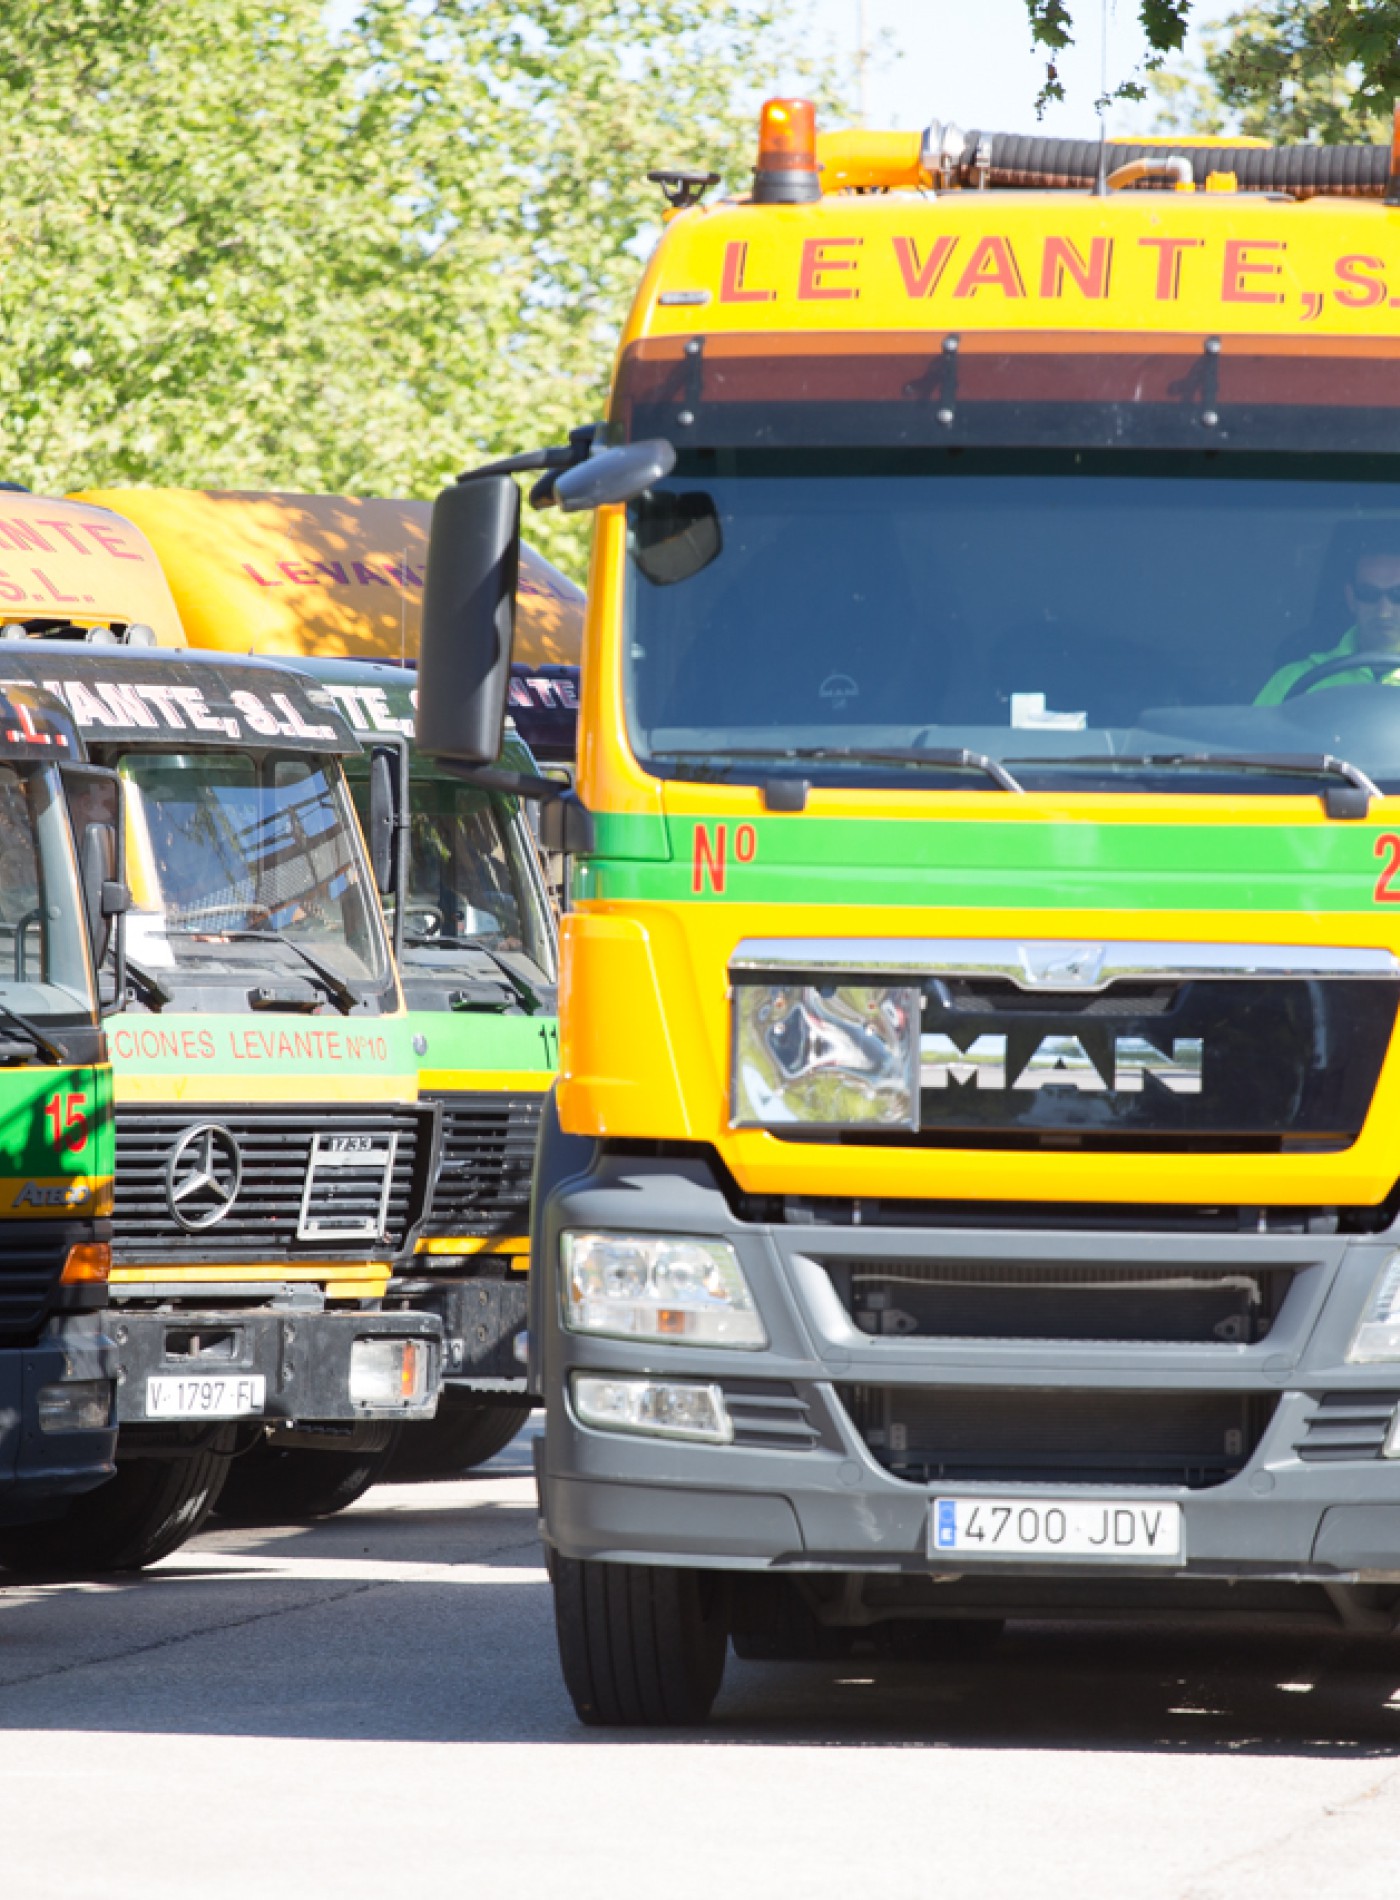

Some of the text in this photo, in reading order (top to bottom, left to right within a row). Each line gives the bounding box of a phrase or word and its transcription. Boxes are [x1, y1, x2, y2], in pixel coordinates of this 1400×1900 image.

[241, 561, 424, 587] LEVAN
[229, 1031, 343, 1059] LEVANTE
[920, 1034, 1204, 1093] MAN
[44, 1092, 88, 1153] 15
[965, 1506, 1162, 1546] 4700 JDV
